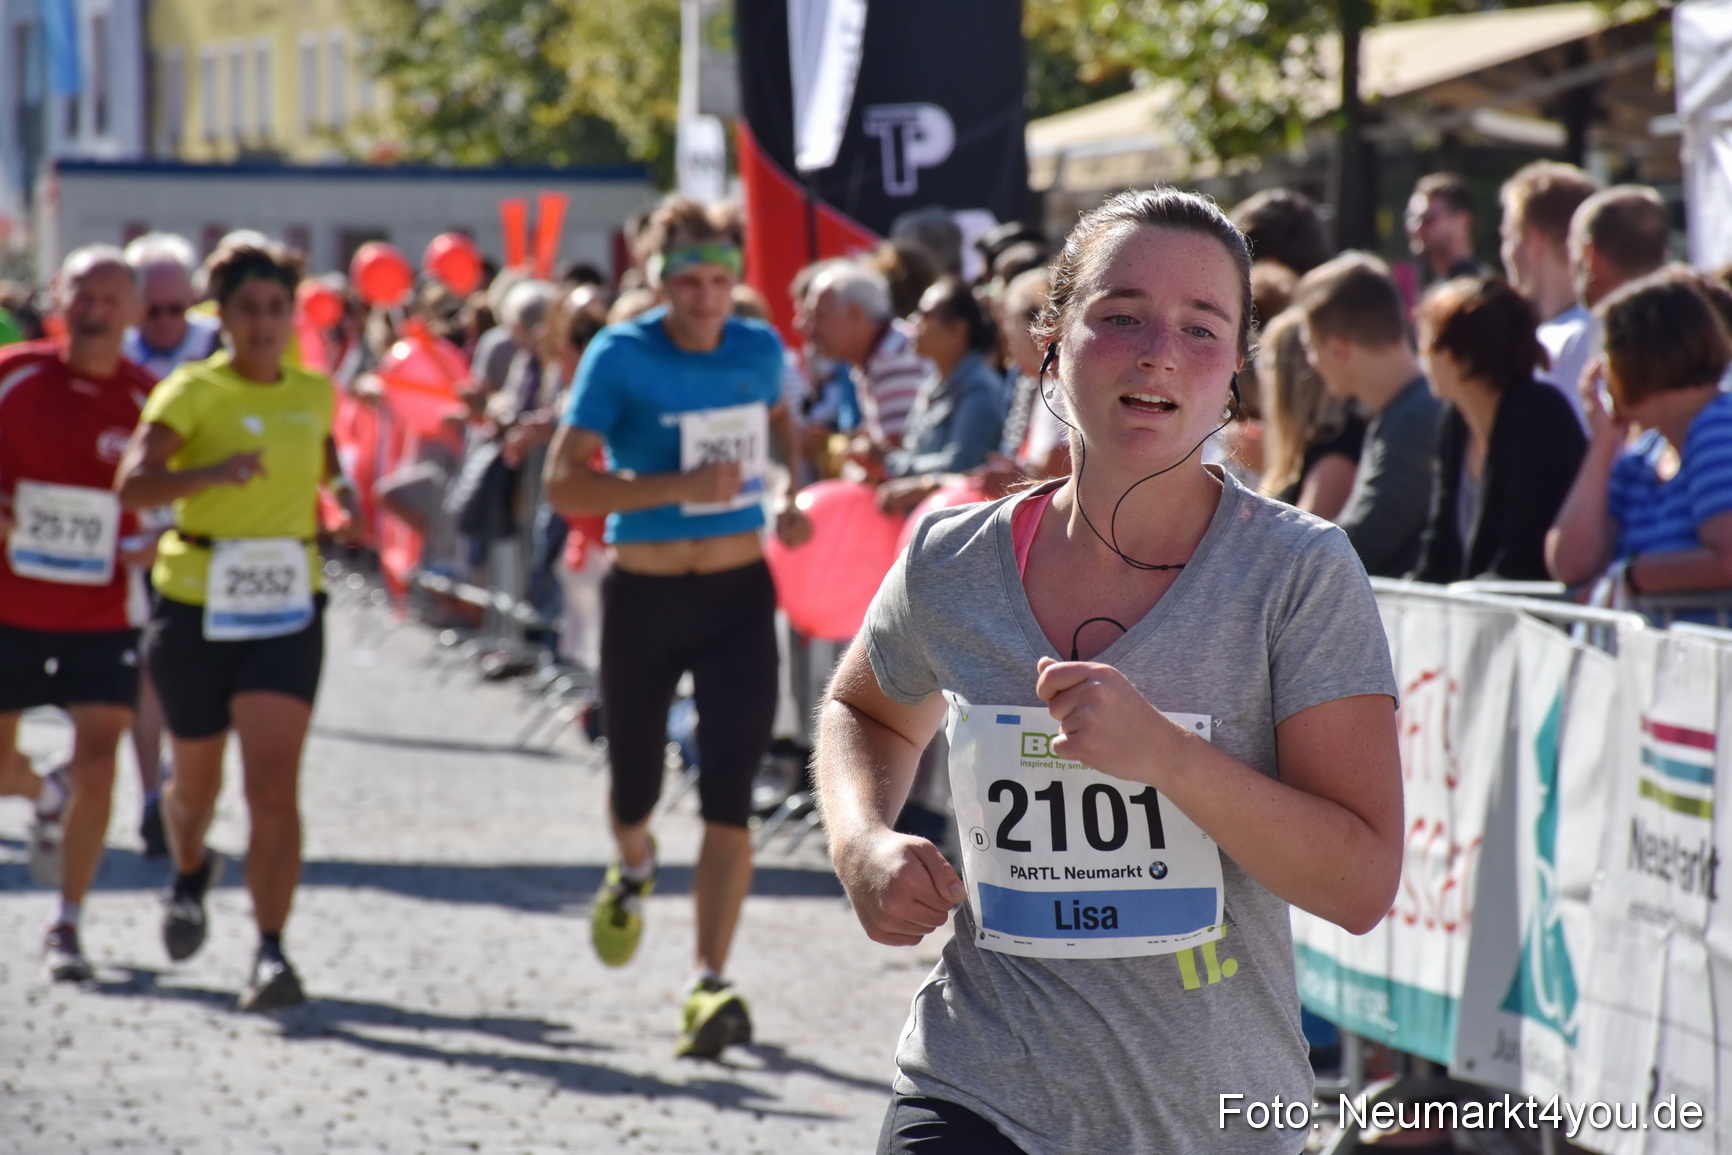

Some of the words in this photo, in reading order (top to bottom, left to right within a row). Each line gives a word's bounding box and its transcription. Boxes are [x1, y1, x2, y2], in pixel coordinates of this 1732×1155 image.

[225, 565, 296, 598] 2552
[1020, 759, 1053, 769] inspired
[1055, 761, 1066, 770] by
[988, 779, 1166, 852] 2101
[1010, 864, 1060, 880] PARTL
[1064, 865, 1143, 880] Neumarkt
[1054, 900, 1118, 930] Lisa
